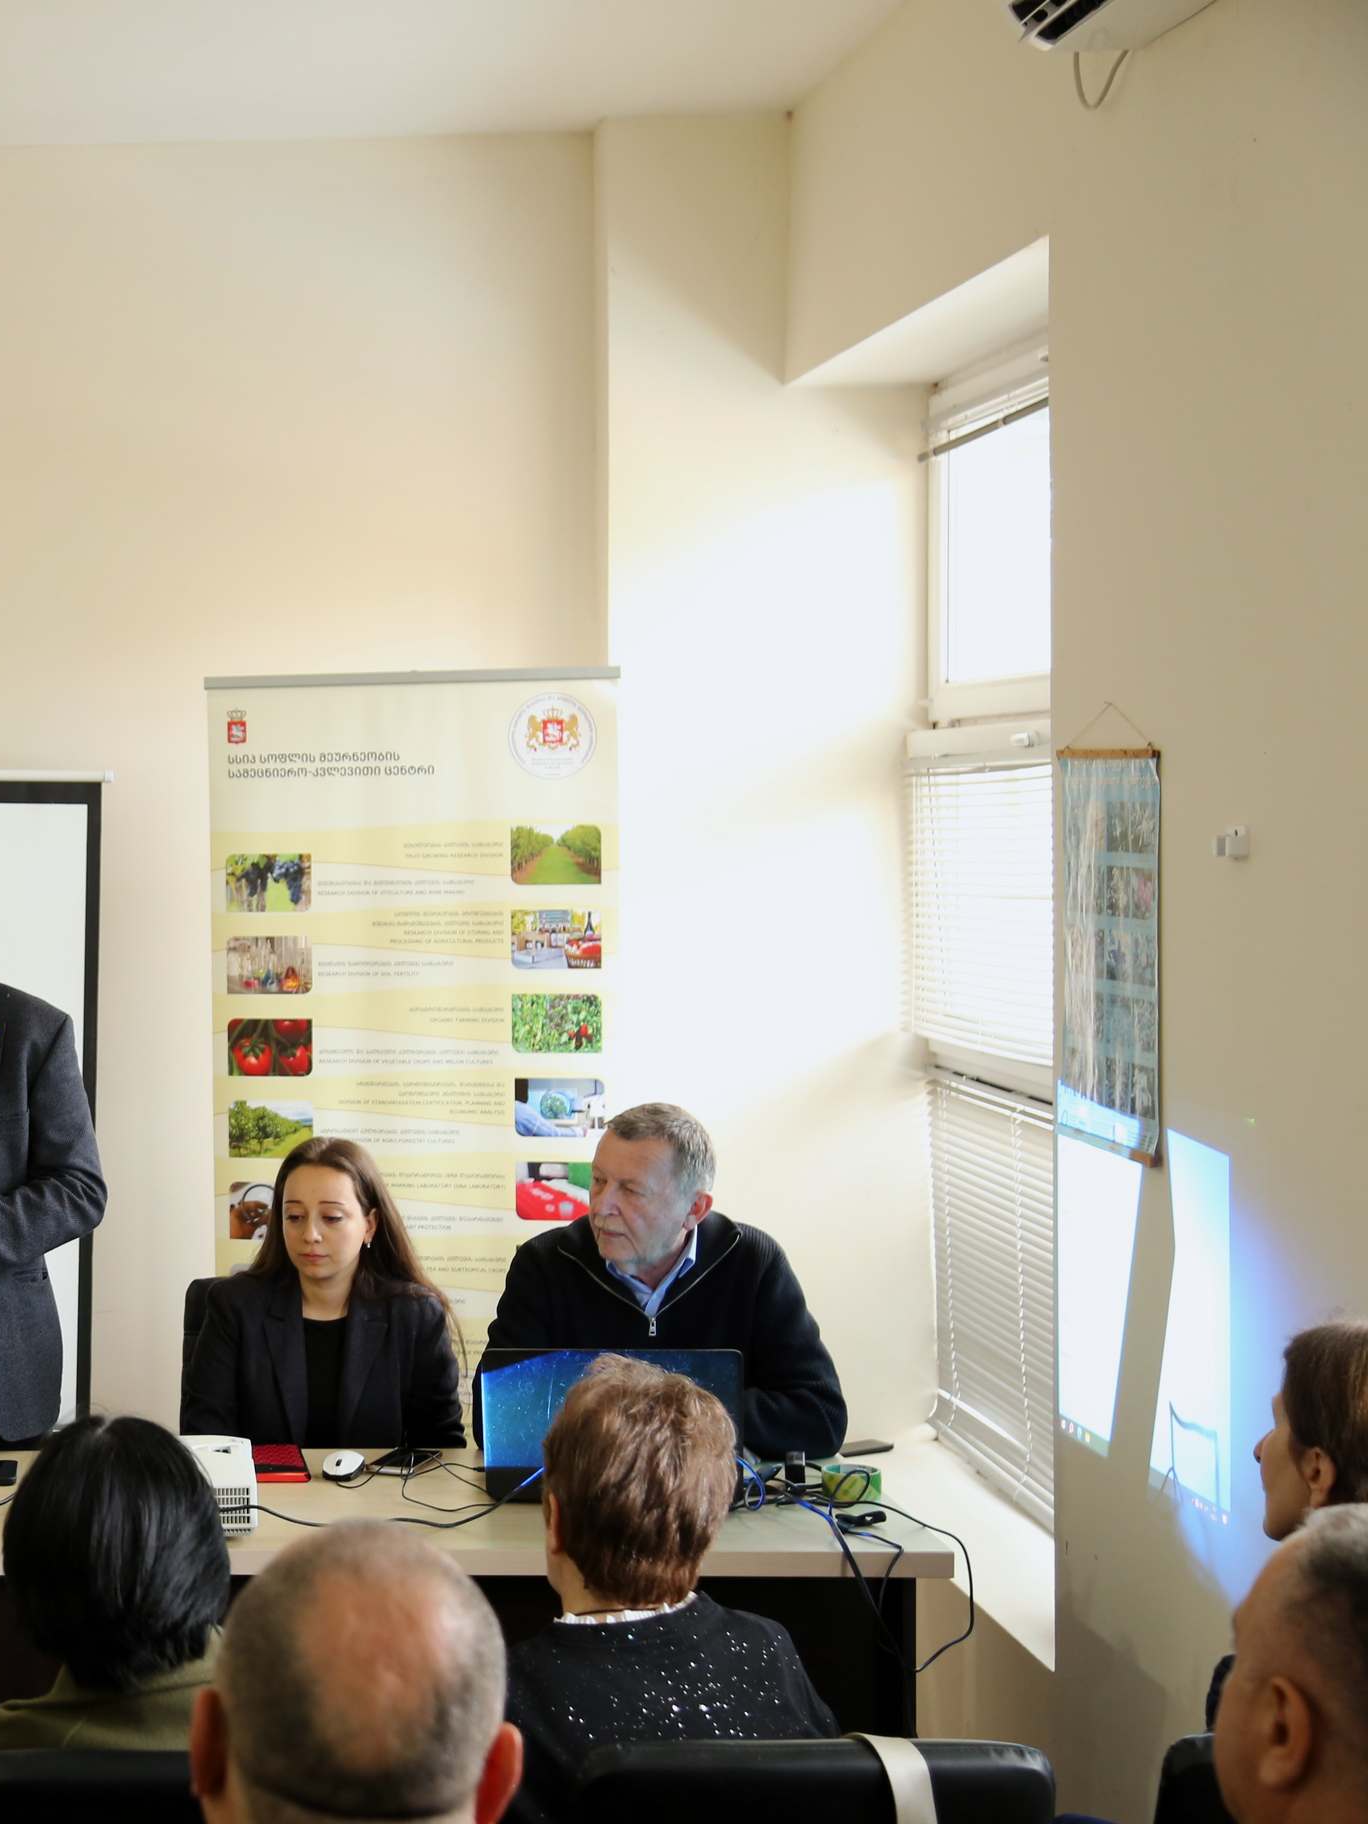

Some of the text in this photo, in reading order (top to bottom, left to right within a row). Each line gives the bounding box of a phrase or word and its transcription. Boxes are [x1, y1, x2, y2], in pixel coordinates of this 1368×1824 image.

[227, 751, 400, 764] სსიპ სოფლის მეურნეობის
[227, 765, 435, 779] სამეცნიერო-კვლევითი ცენტრი
